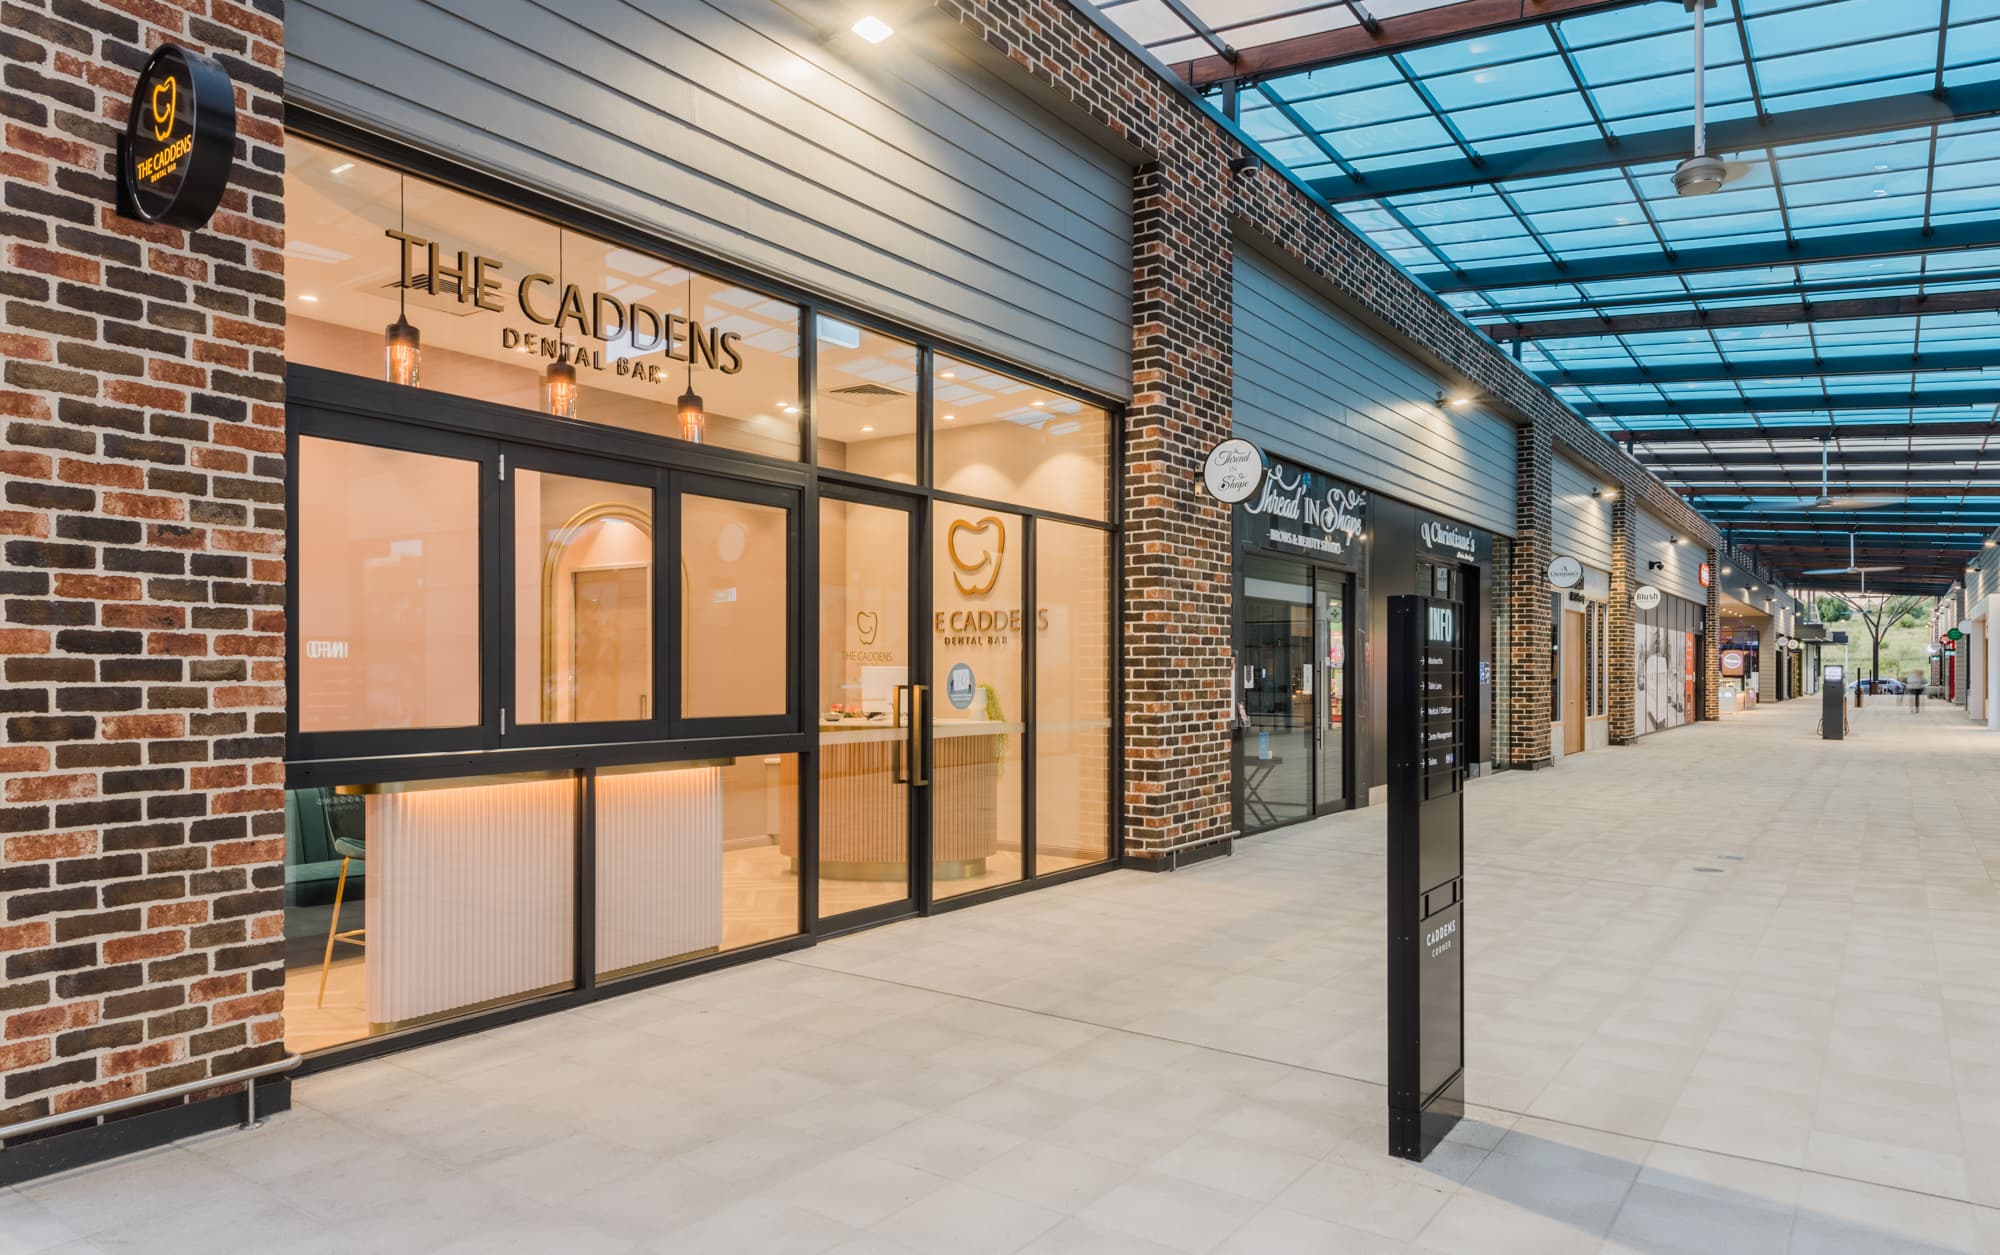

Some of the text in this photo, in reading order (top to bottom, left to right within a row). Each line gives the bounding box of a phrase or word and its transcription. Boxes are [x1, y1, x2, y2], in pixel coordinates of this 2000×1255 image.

[137, 134, 192, 180] THE CADDENS
[385, 229, 744, 375] THE CADDENS
[503, 327, 662, 383] DENTAL BAR
[1215, 450, 1251, 467] Thread
[1243, 464, 1363, 546] Thread IN Shape
[950, 607, 1048, 633] CADDES
[1428, 606, 1452, 642] INFO
[944, 635, 1008, 646] DENTAL BAR
[1426, 919, 1456, 947] CADDENS
